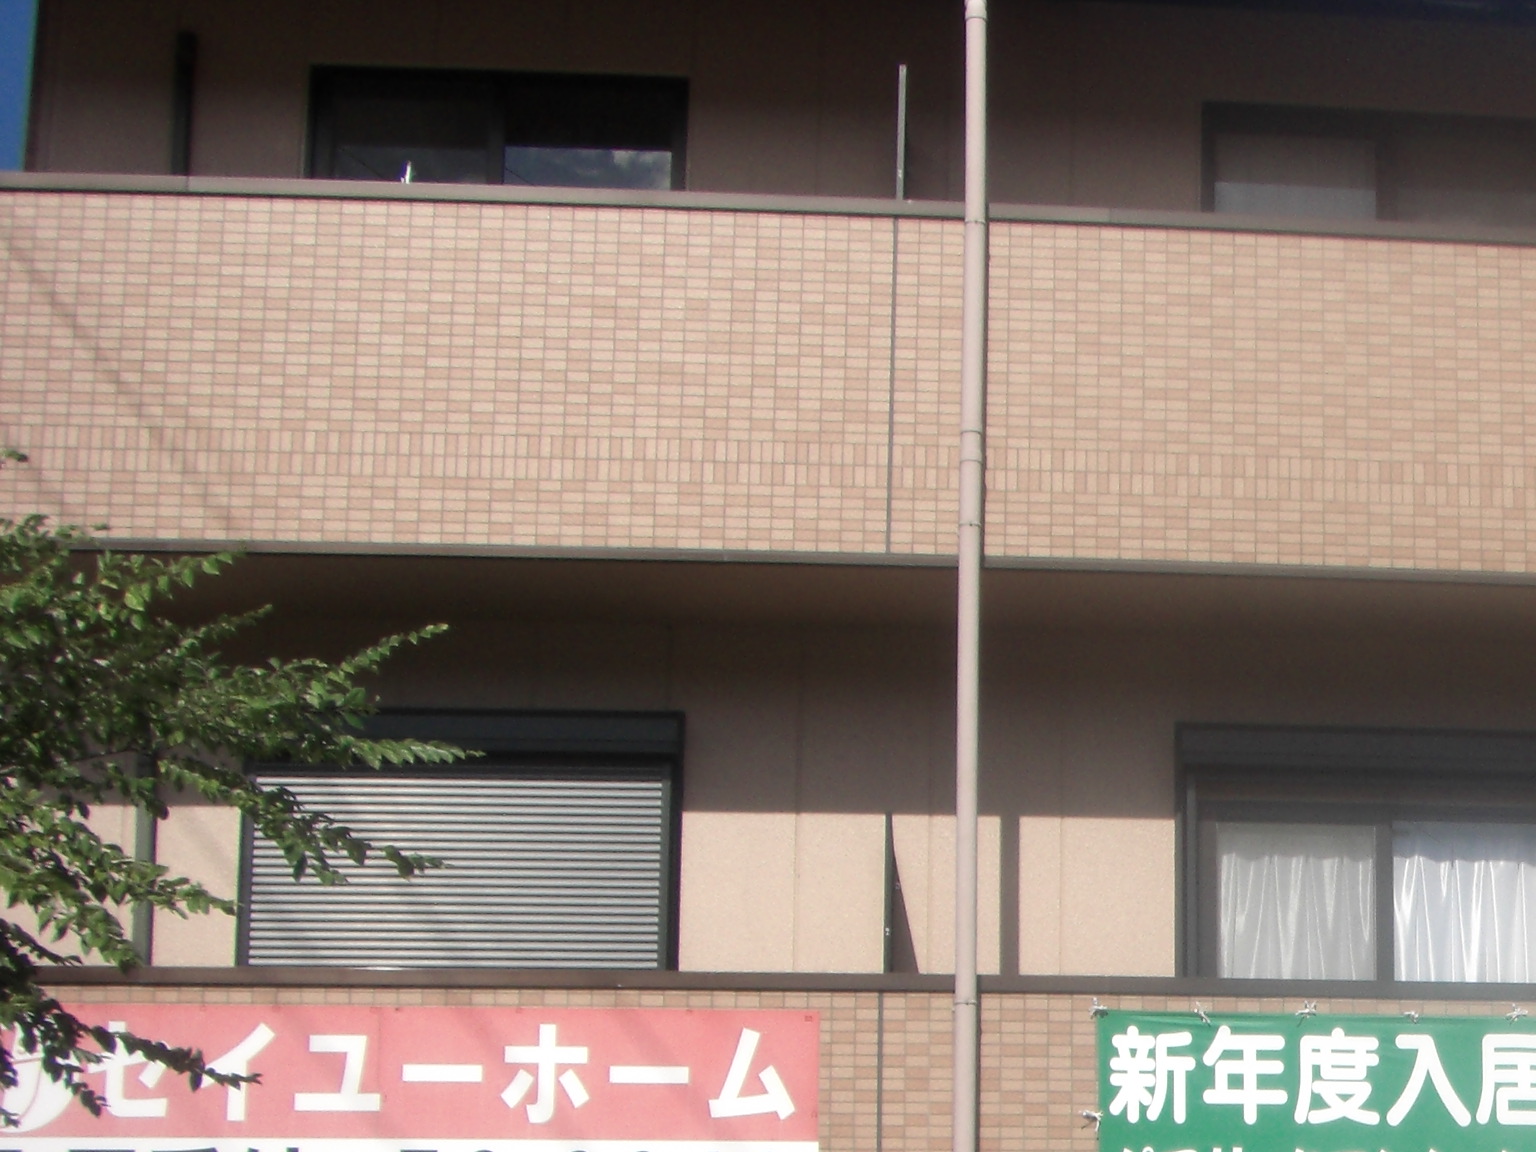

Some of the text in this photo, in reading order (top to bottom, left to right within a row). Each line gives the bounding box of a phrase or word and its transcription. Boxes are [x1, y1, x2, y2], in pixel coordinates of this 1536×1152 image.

[88, 1022, 797, 1123] セイユーホーム
